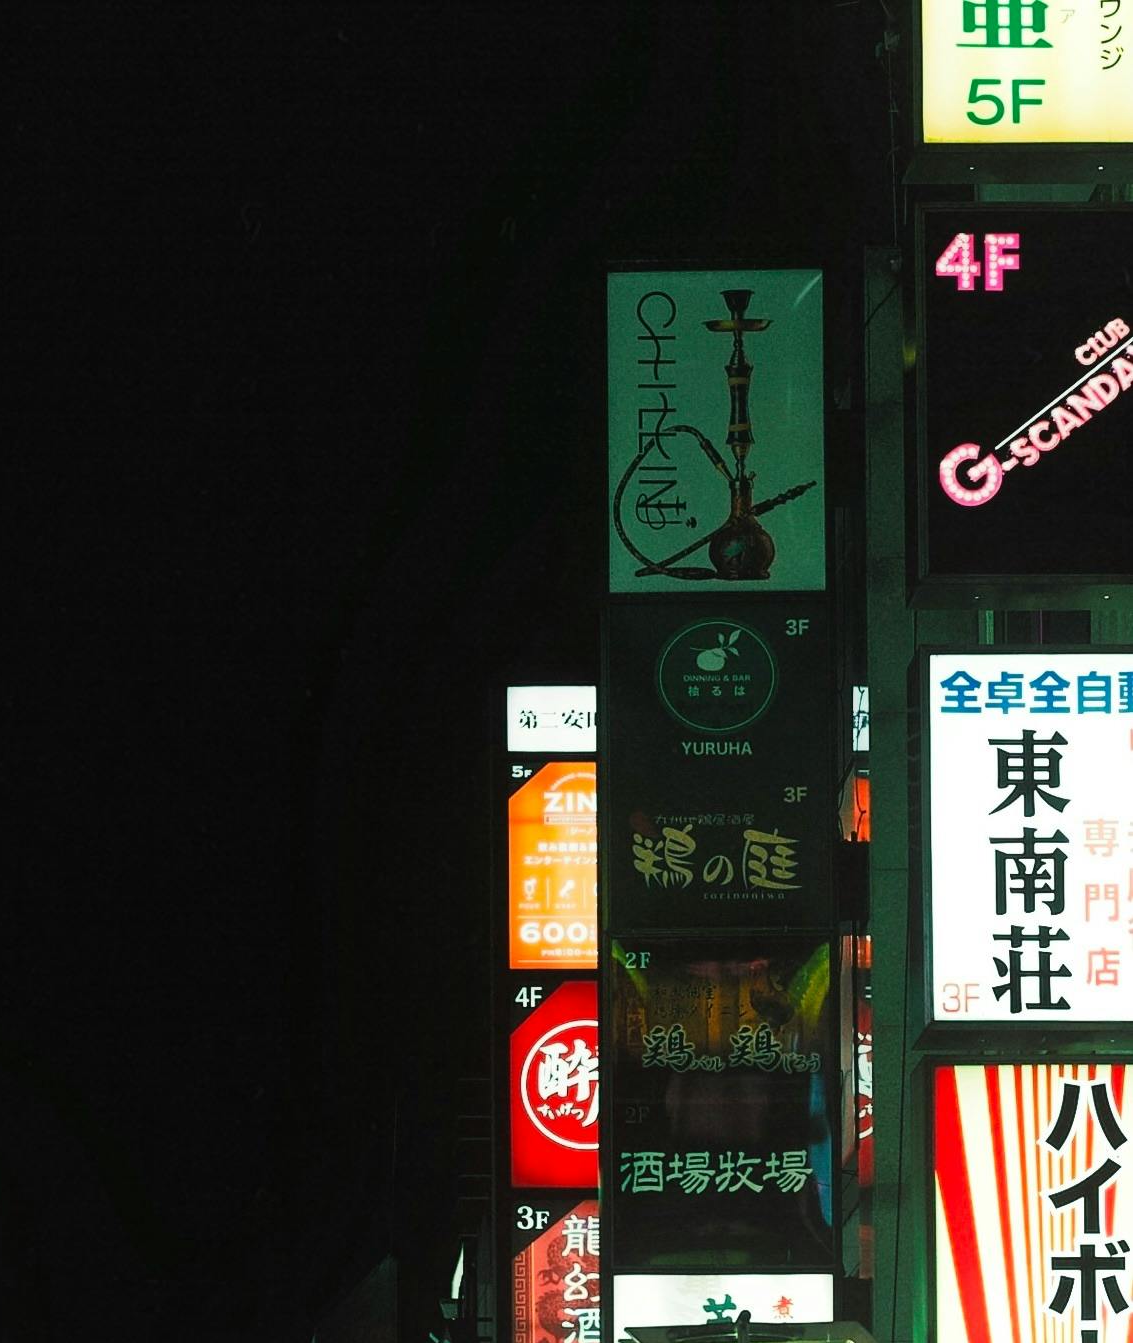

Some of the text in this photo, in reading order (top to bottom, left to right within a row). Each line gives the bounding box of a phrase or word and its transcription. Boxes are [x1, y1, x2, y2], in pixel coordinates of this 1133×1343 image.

[966, 78, 1046, 126] 5F
[935, 232, 1020, 291] 4F
[1074, 317, 1131, 367] CLUB
[786, 618, 810, 637] 3F
[681, 740, 753, 756] YURUHA
[511, 765, 534, 779] 5F
[783, 786, 808, 803] 3F
[987, 728, 1073, 1015] 東南荘
[1081, 817, 1121, 987] 専門店
[625, 951, 651, 970] 2F
[515, 986, 543, 1009] 4F
[942, 982, 980, 1013] 3F
[625, 1106, 651, 1124] 2F
[619, 1150, 814, 1195] 酒場牧場
[516, 1206, 551, 1231] 3F
